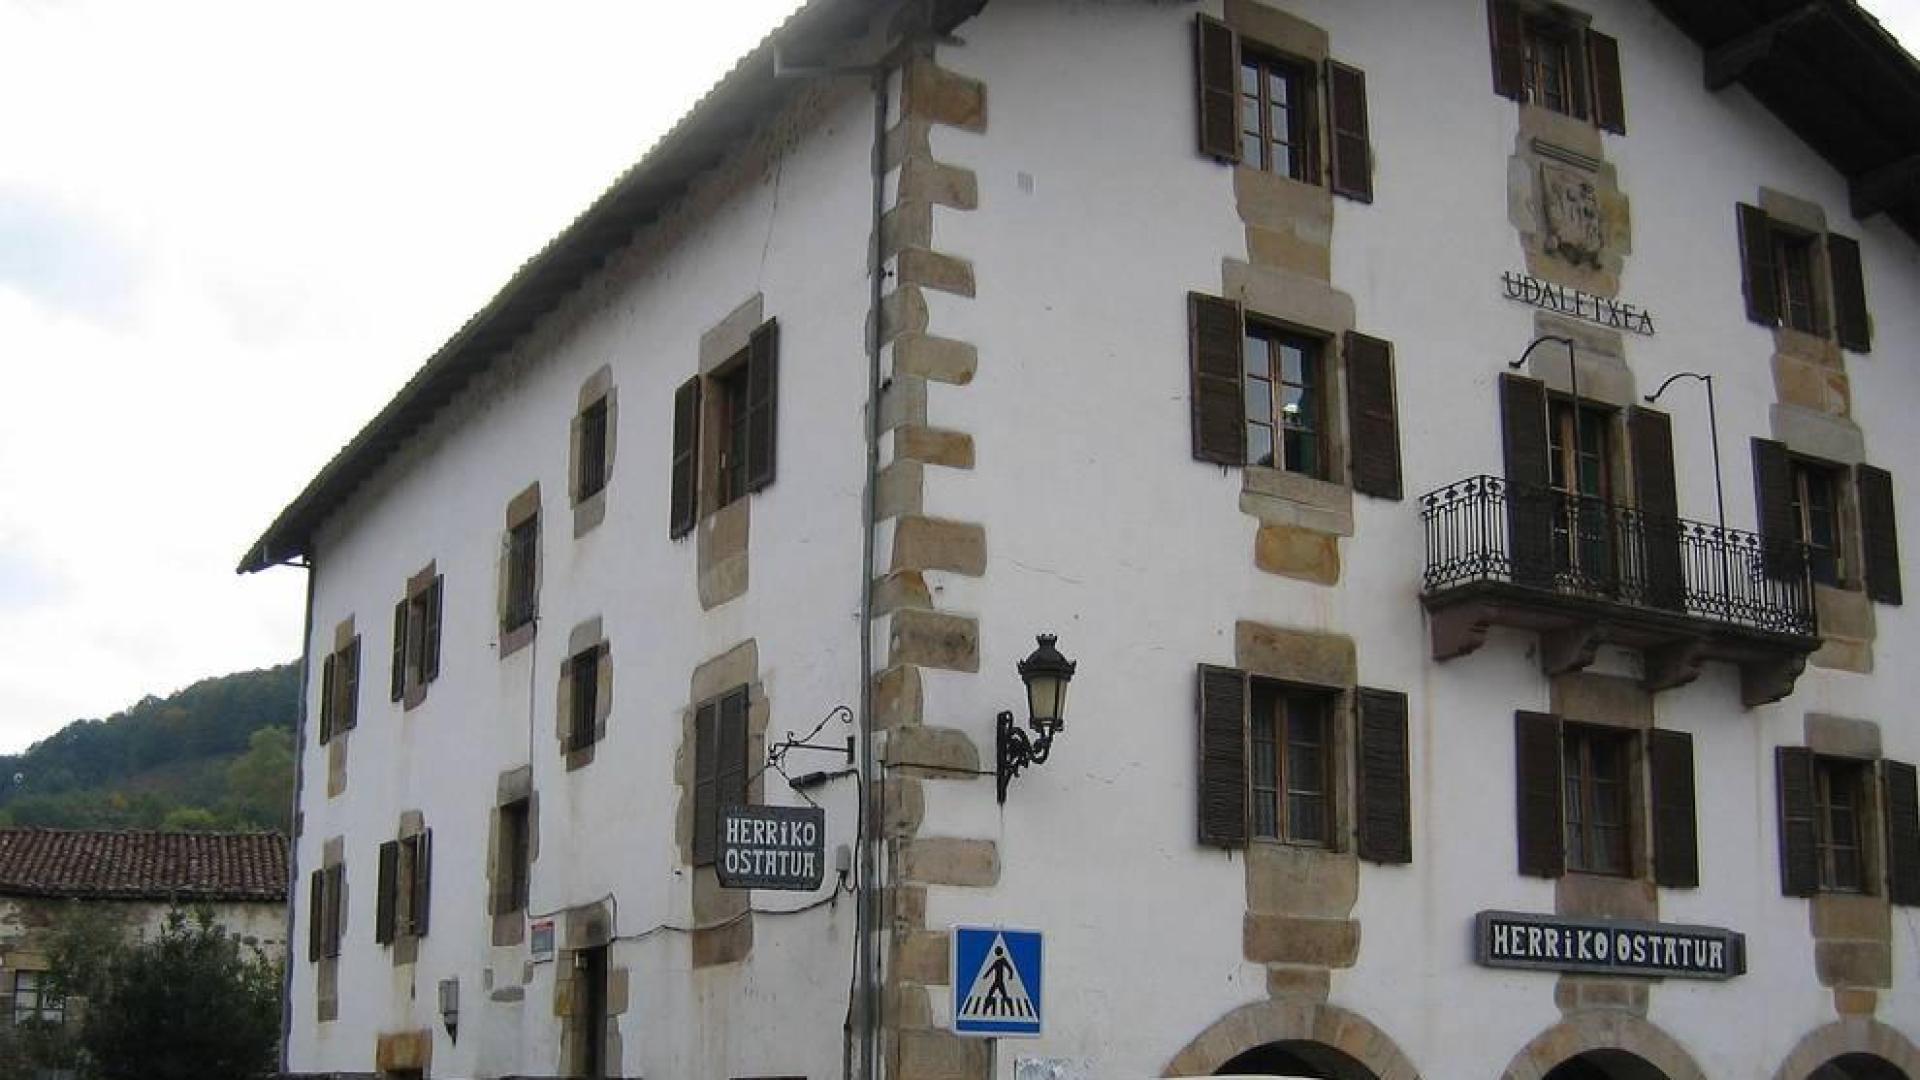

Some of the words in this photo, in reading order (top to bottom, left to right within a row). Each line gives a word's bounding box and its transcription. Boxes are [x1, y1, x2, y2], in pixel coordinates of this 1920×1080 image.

[1503, 271, 1655, 335] UDALETXEA
[725, 848, 816, 878] OSTATUA
[1616, 933, 1723, 969] OSTATUA
